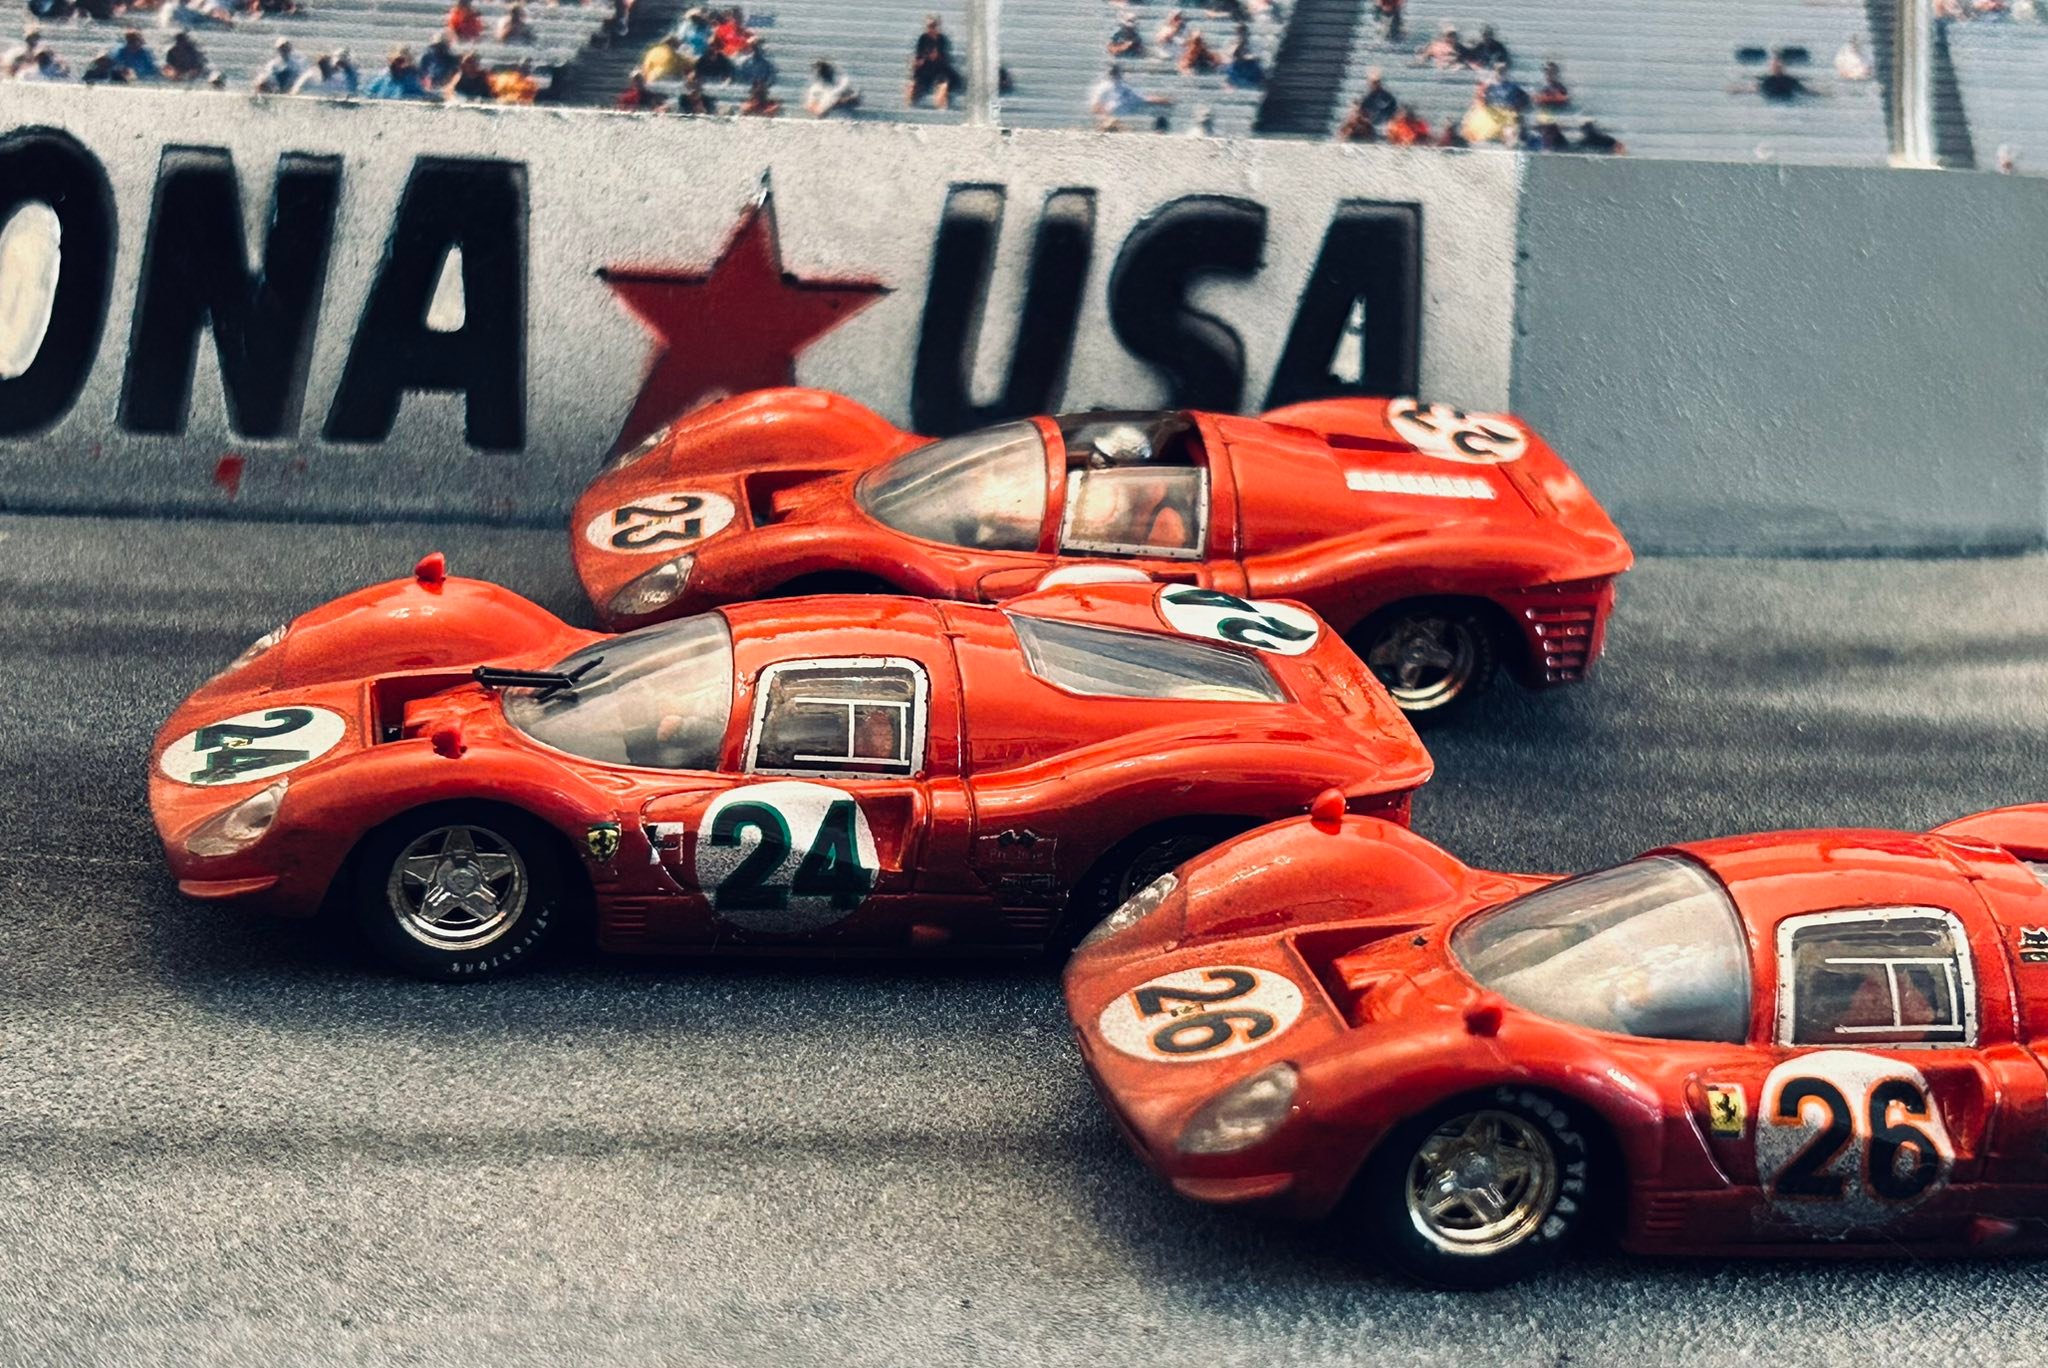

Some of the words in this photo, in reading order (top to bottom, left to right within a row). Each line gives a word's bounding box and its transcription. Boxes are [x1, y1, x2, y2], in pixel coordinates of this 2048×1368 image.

[0, 125, 530, 452] ONA
[909, 181, 1424, 437] USA
[611, 496, 704, 549] 23
[1161, 589, 1317, 650] 24
[190, 708, 315, 784] 24
[711, 800, 872, 911] 24
[1129, 969, 1280, 1056] 26
[1770, 1074, 1940, 1201] 26
